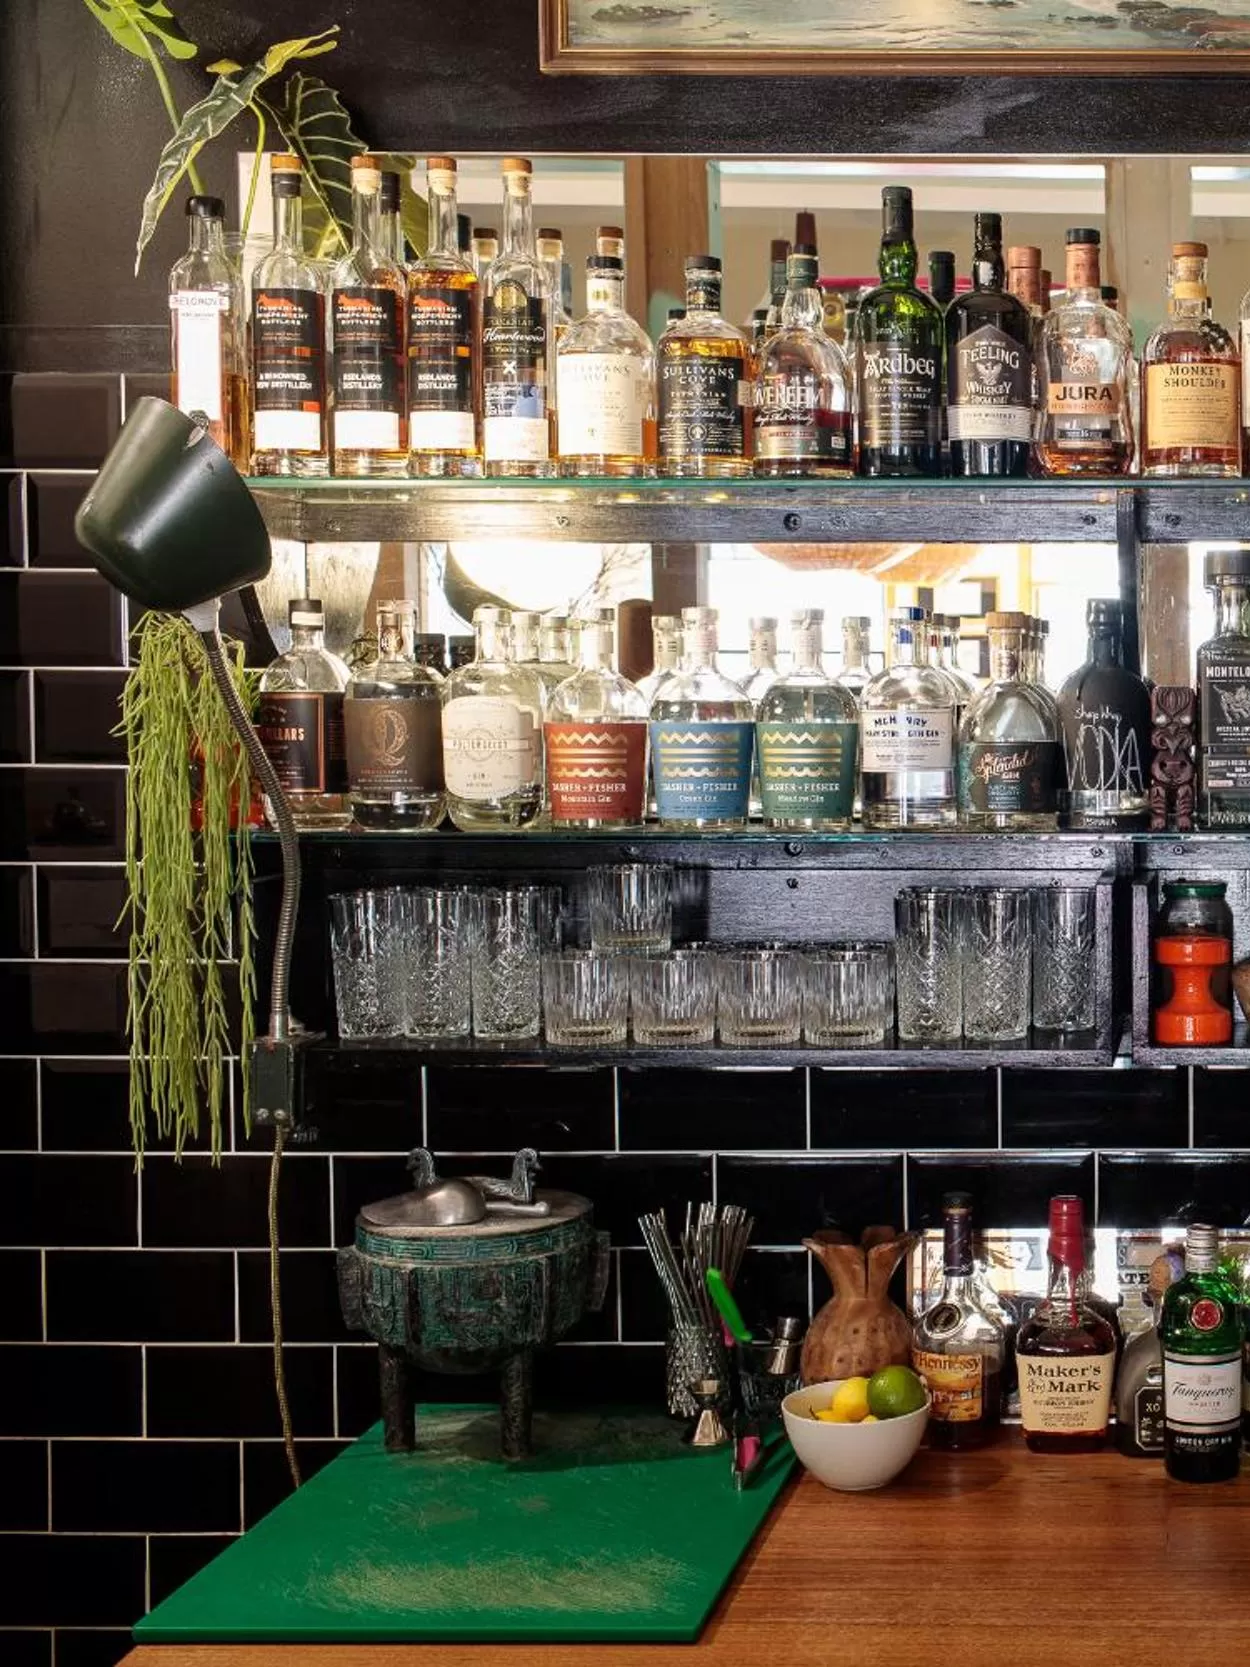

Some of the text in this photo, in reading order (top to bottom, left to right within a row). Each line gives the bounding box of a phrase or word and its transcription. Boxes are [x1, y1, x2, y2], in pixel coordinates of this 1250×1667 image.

[862, 350, 935, 380] Ardbeg
[959, 346, 1020, 369] TEELING
[663, 365, 735, 380] SULLIVANS
[1169, 365, 1222, 377] MONKEY
[679, 374, 718, 385] COVE
[1055, 386, 1113, 401] JURA
[914, 1352, 981, 1371] Hennessy
[1026, 1363, 1102, 1378] Maker's
[1047, 1380, 1102, 1393] Mark
[1171, 1381, 1236, 1401] Tanqueray
